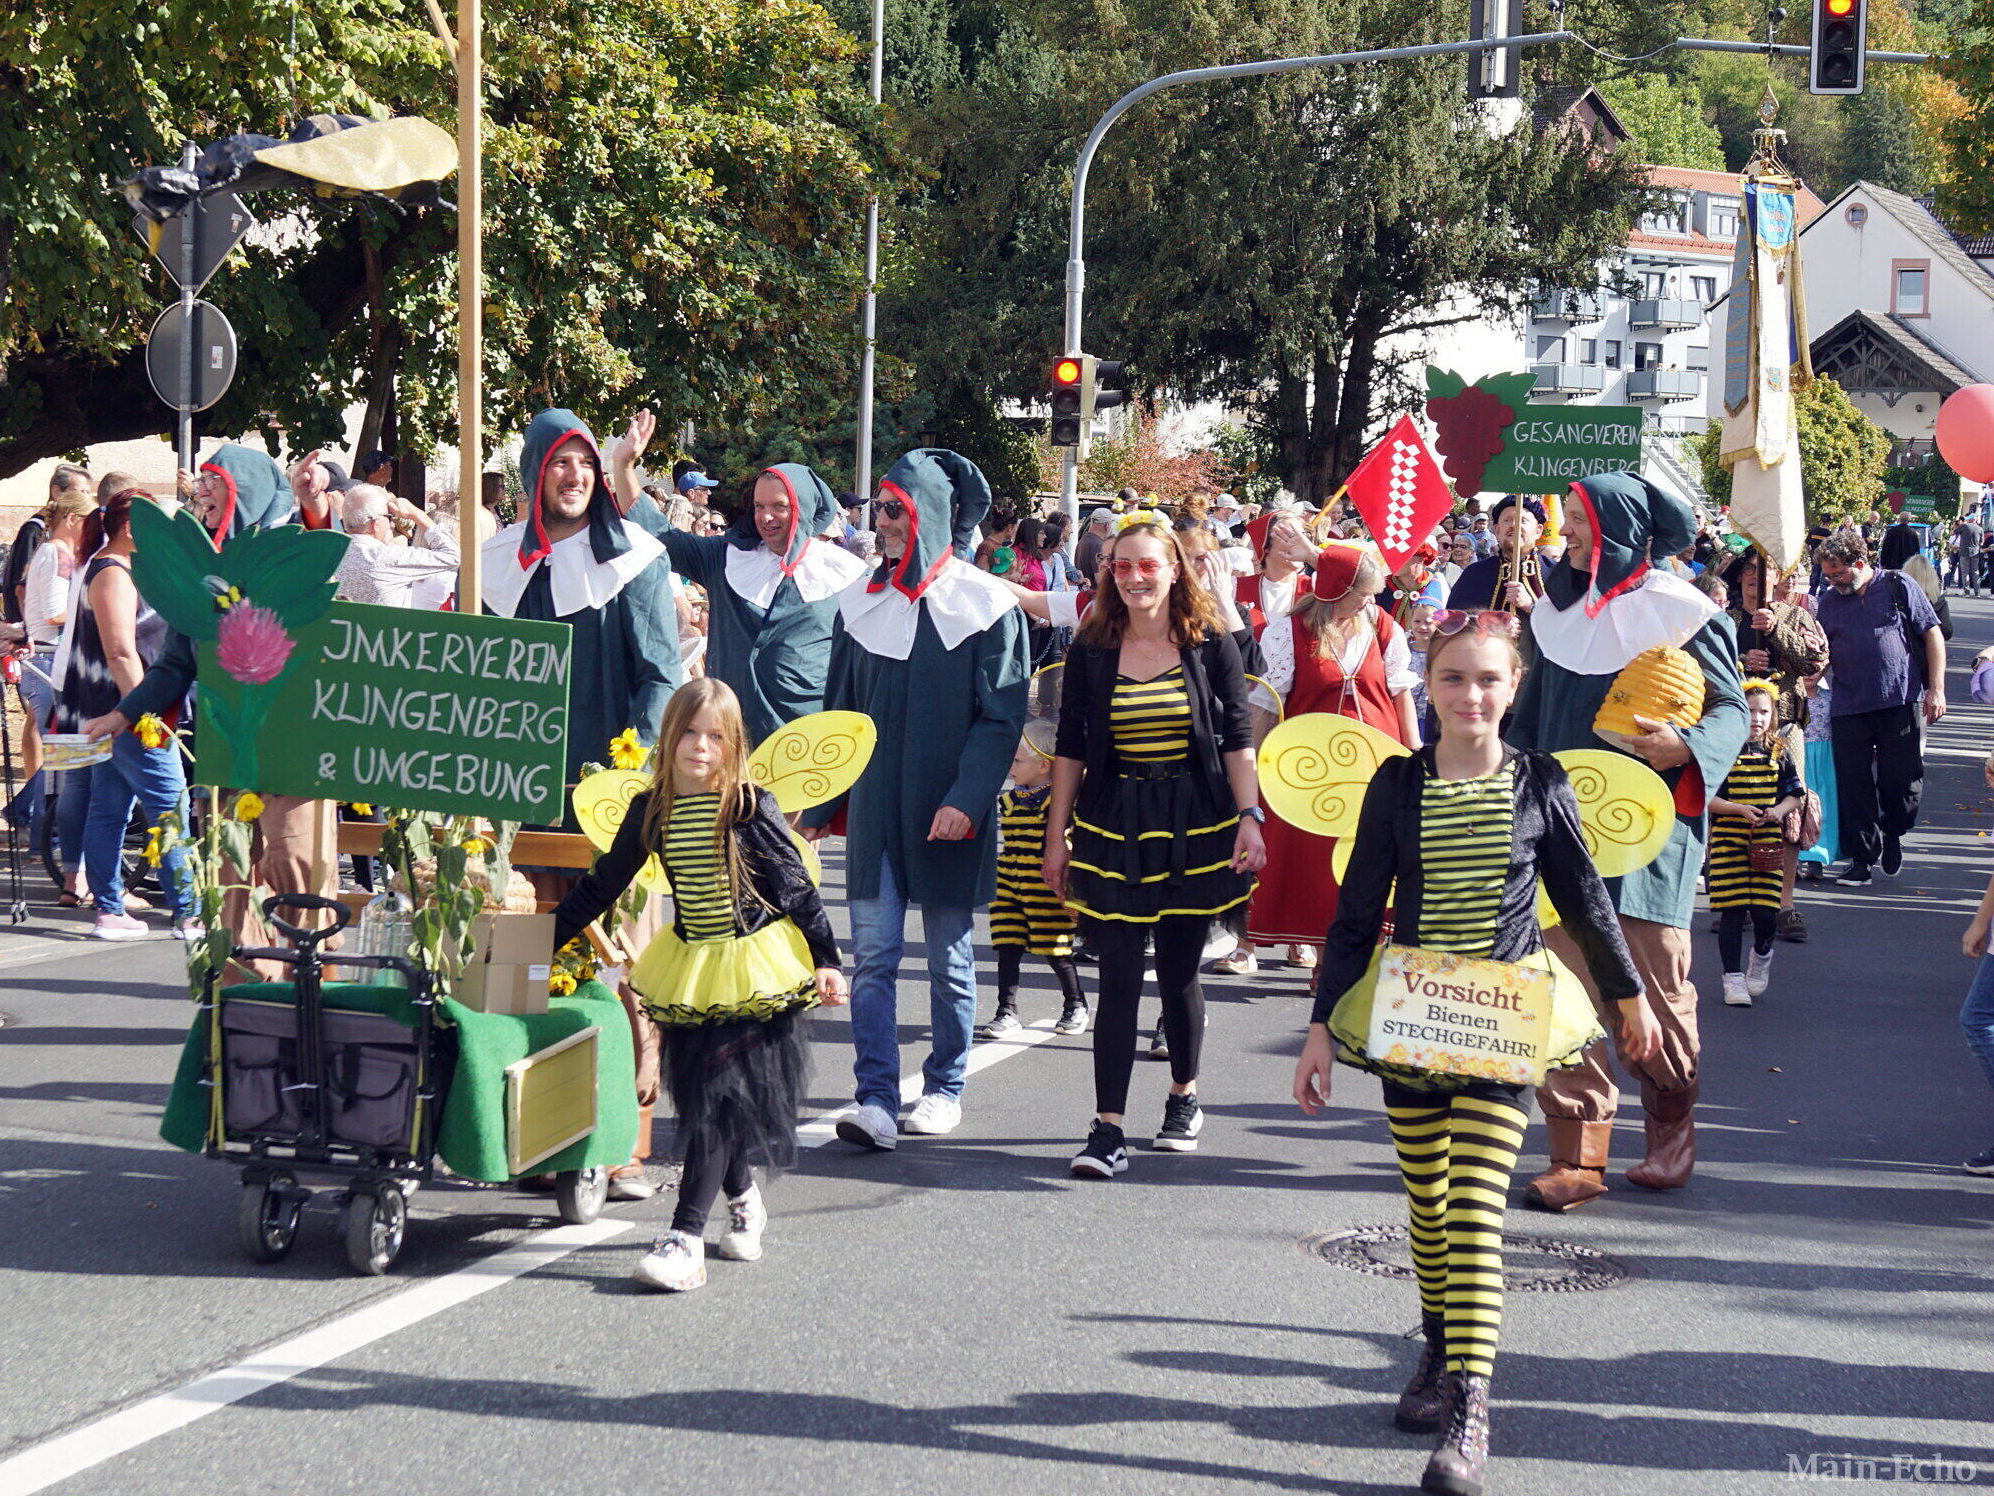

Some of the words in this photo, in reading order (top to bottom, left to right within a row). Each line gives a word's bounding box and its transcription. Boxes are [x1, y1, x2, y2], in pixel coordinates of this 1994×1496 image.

[1513, 421, 1642, 446] GESANGVEREIN
[312, 679, 565, 744] KLINGENBERG
[318, 752, 336, 780] &
[353, 746, 552, 803] UMGEBUNG
[1403, 971, 1523, 1011] Vorsicht
[1426, 1004, 1498, 1031] Bienen
[1383, 1019, 1537, 1058] STECHGEFAHR!
